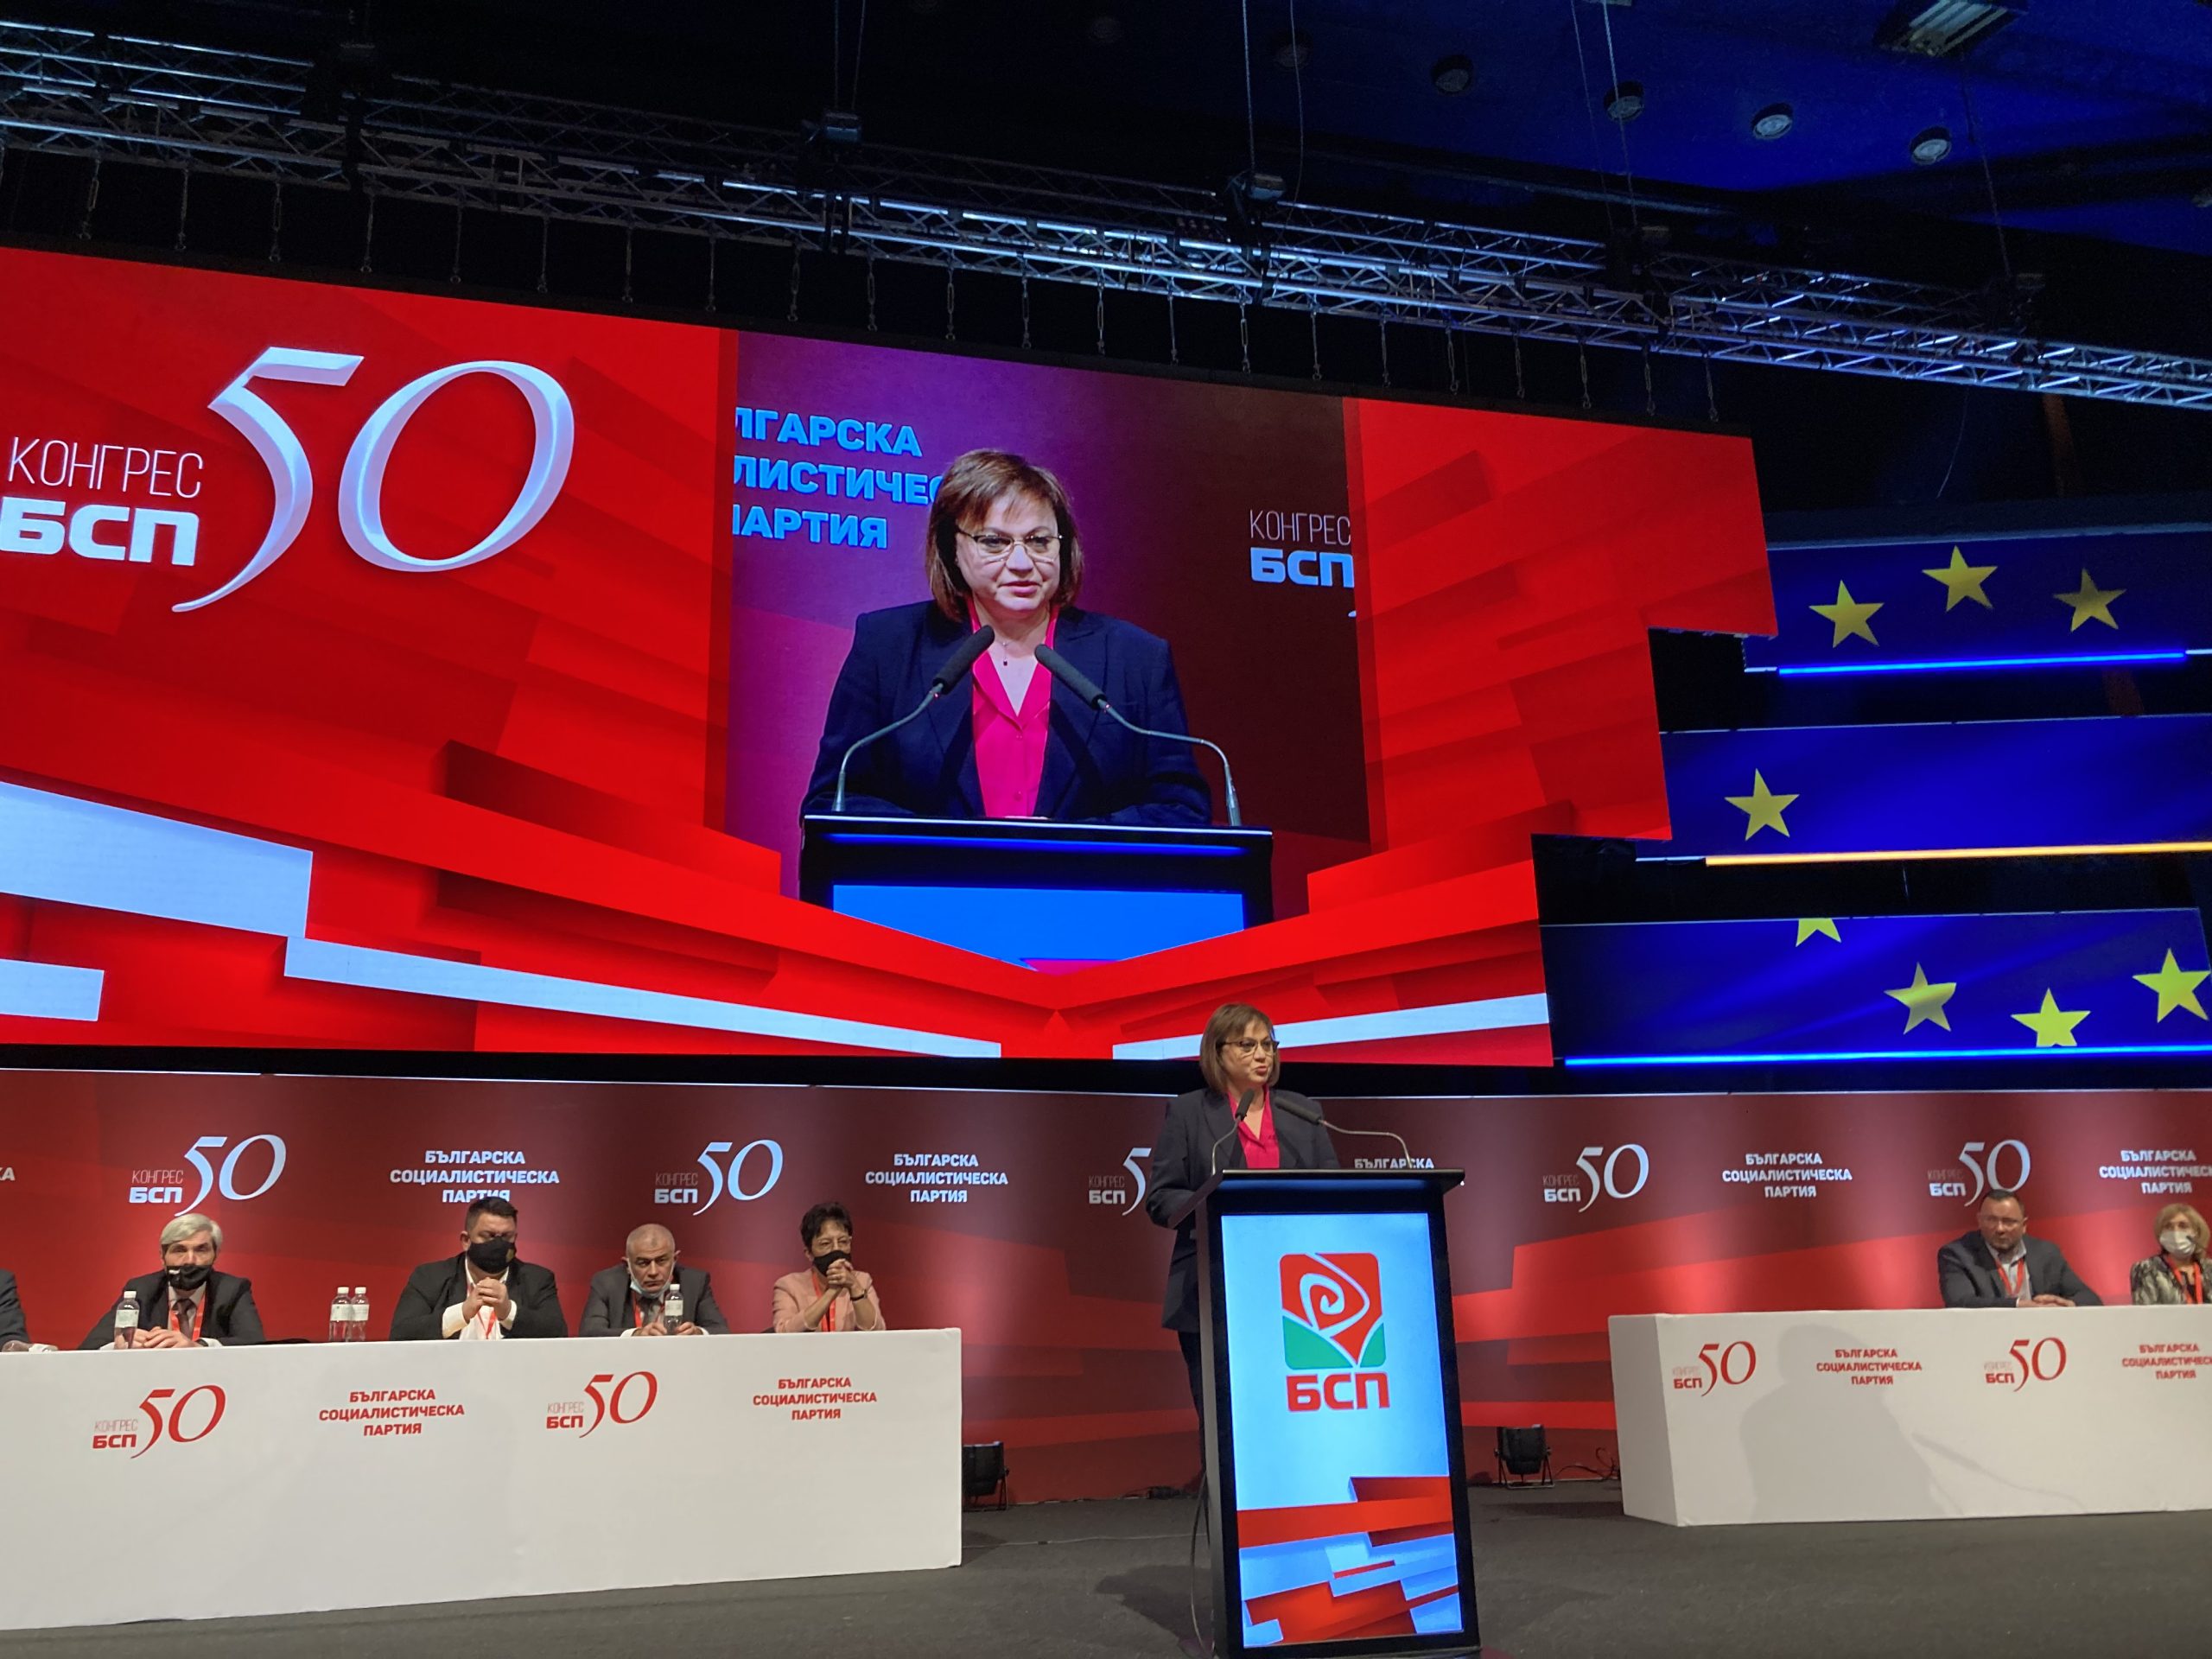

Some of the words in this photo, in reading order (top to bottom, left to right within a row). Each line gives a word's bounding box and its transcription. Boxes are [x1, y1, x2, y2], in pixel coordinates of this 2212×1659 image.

[8, 436, 204, 499] КОНГРЕС
[173, 346, 575, 613] 50
[0, 496, 200, 566] БСП
[1250, 509, 1351, 545] КОНГРЕС
[1250, 547, 1354, 588] БСП
[424, 1150, 525, 1164] БЪЛГАРСКА
[893, 1154, 978, 1166] БЪЛГАРСКА
[1745, 1153, 1822, 1165] БЪЛГАРСКА
[2120, 1150, 2196, 1161] БЪЛГАРСКА
[131, 1169, 184, 1185] КОНГРЕС
[175, 1134, 287, 1217] 50
[390, 1169, 560, 1185] СОЦИАЛИСТИЧЕСКА
[655, 1172, 698, 1186] КОНГРЕС
[693, 1140, 784, 1216] 50
[865, 1171, 1008, 1185] СОЦИАЛИСТИЧЕСКА
[1576, 1143, 1649, 1212] 50
[1722, 1169, 1853, 1183] СОЦИАЛИСТИЧЕСКА
[1959, 1139, 2031, 1207] 50
[129, 1186, 181, 1204] БСП
[1543, 1188, 1581, 1203] БСП
[1764, 1185, 1816, 1198] ПАРТИЯ
[1929, 1183, 1967, 1197] БСП
[2141, 1182, 2192, 1194] ПАРТИЯ
[654, 1188, 697, 1204] БСП
[910, 1190, 968, 1202] ПАРТИЯ
[1089, 1190, 1126, 1205] БСП
[1835, 1349, 1898, 1359] БЪЛГАРСКА
[1699, 1341, 1757, 1396] 50
[1815, 1362, 1923, 1372] СОЦИАЛИСТИЧЕСКА
[2009, 1337, 2067, 1392] 50
[778, 1377, 851, 1389] БЪЛГАРСКА
[1674, 1378, 1702, 1389] БСП
[1851, 1375, 1894, 1385] ПАРТИЯ
[1986, 1373, 2015, 1383] БСП
[349, 1389, 435, 1403] БЪЛГАРСКА
[753, 1392, 876, 1407] СОЦИАЛИСТИЧЕСКА
[1286, 1371, 1390, 1413] БСП
[579, 1371, 658, 1439] 50
[319, 1405, 465, 1421] СОЦИАЛИСТИЧЕСКА
[791, 1408, 842, 1421] ПАРТИЯ
[130, 1384, 226, 1459] 50
[546, 1415, 583, 1429] БСП
[363, 1423, 422, 1436] ПАРТИЯ
[92, 1434, 137, 1449] БСП
